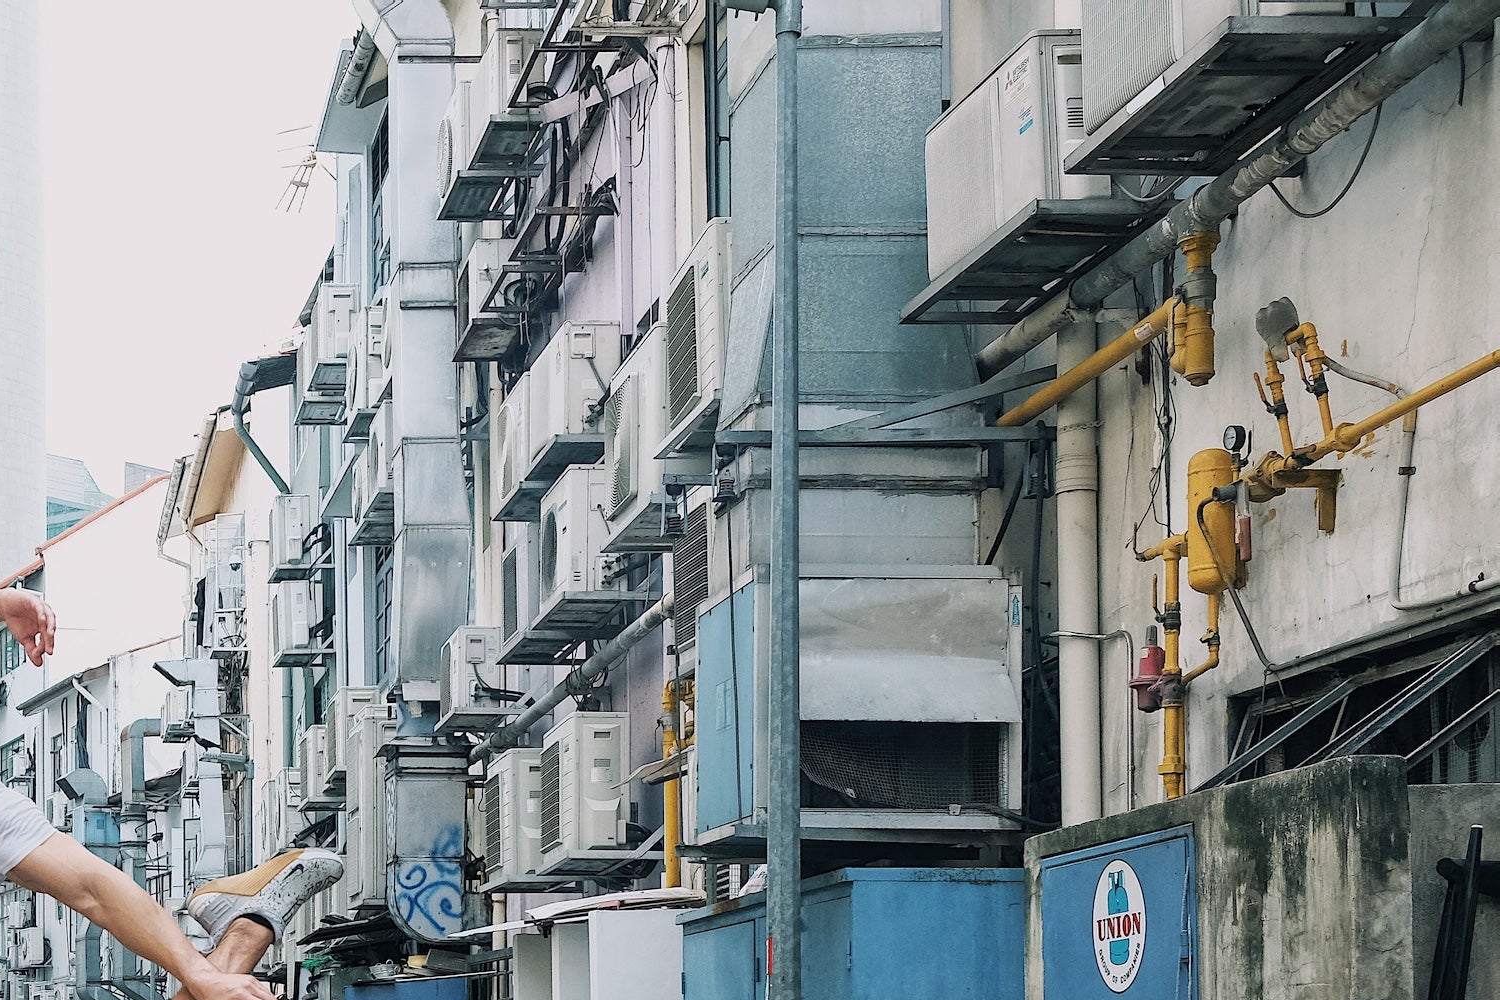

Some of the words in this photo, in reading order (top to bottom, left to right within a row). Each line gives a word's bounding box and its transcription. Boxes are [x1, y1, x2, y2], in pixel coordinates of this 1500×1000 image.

[1097, 911, 1141, 942] UNION
[1099, 948, 1111, 978] GROUP
[1120, 942, 1141, 985] COMPANIES
